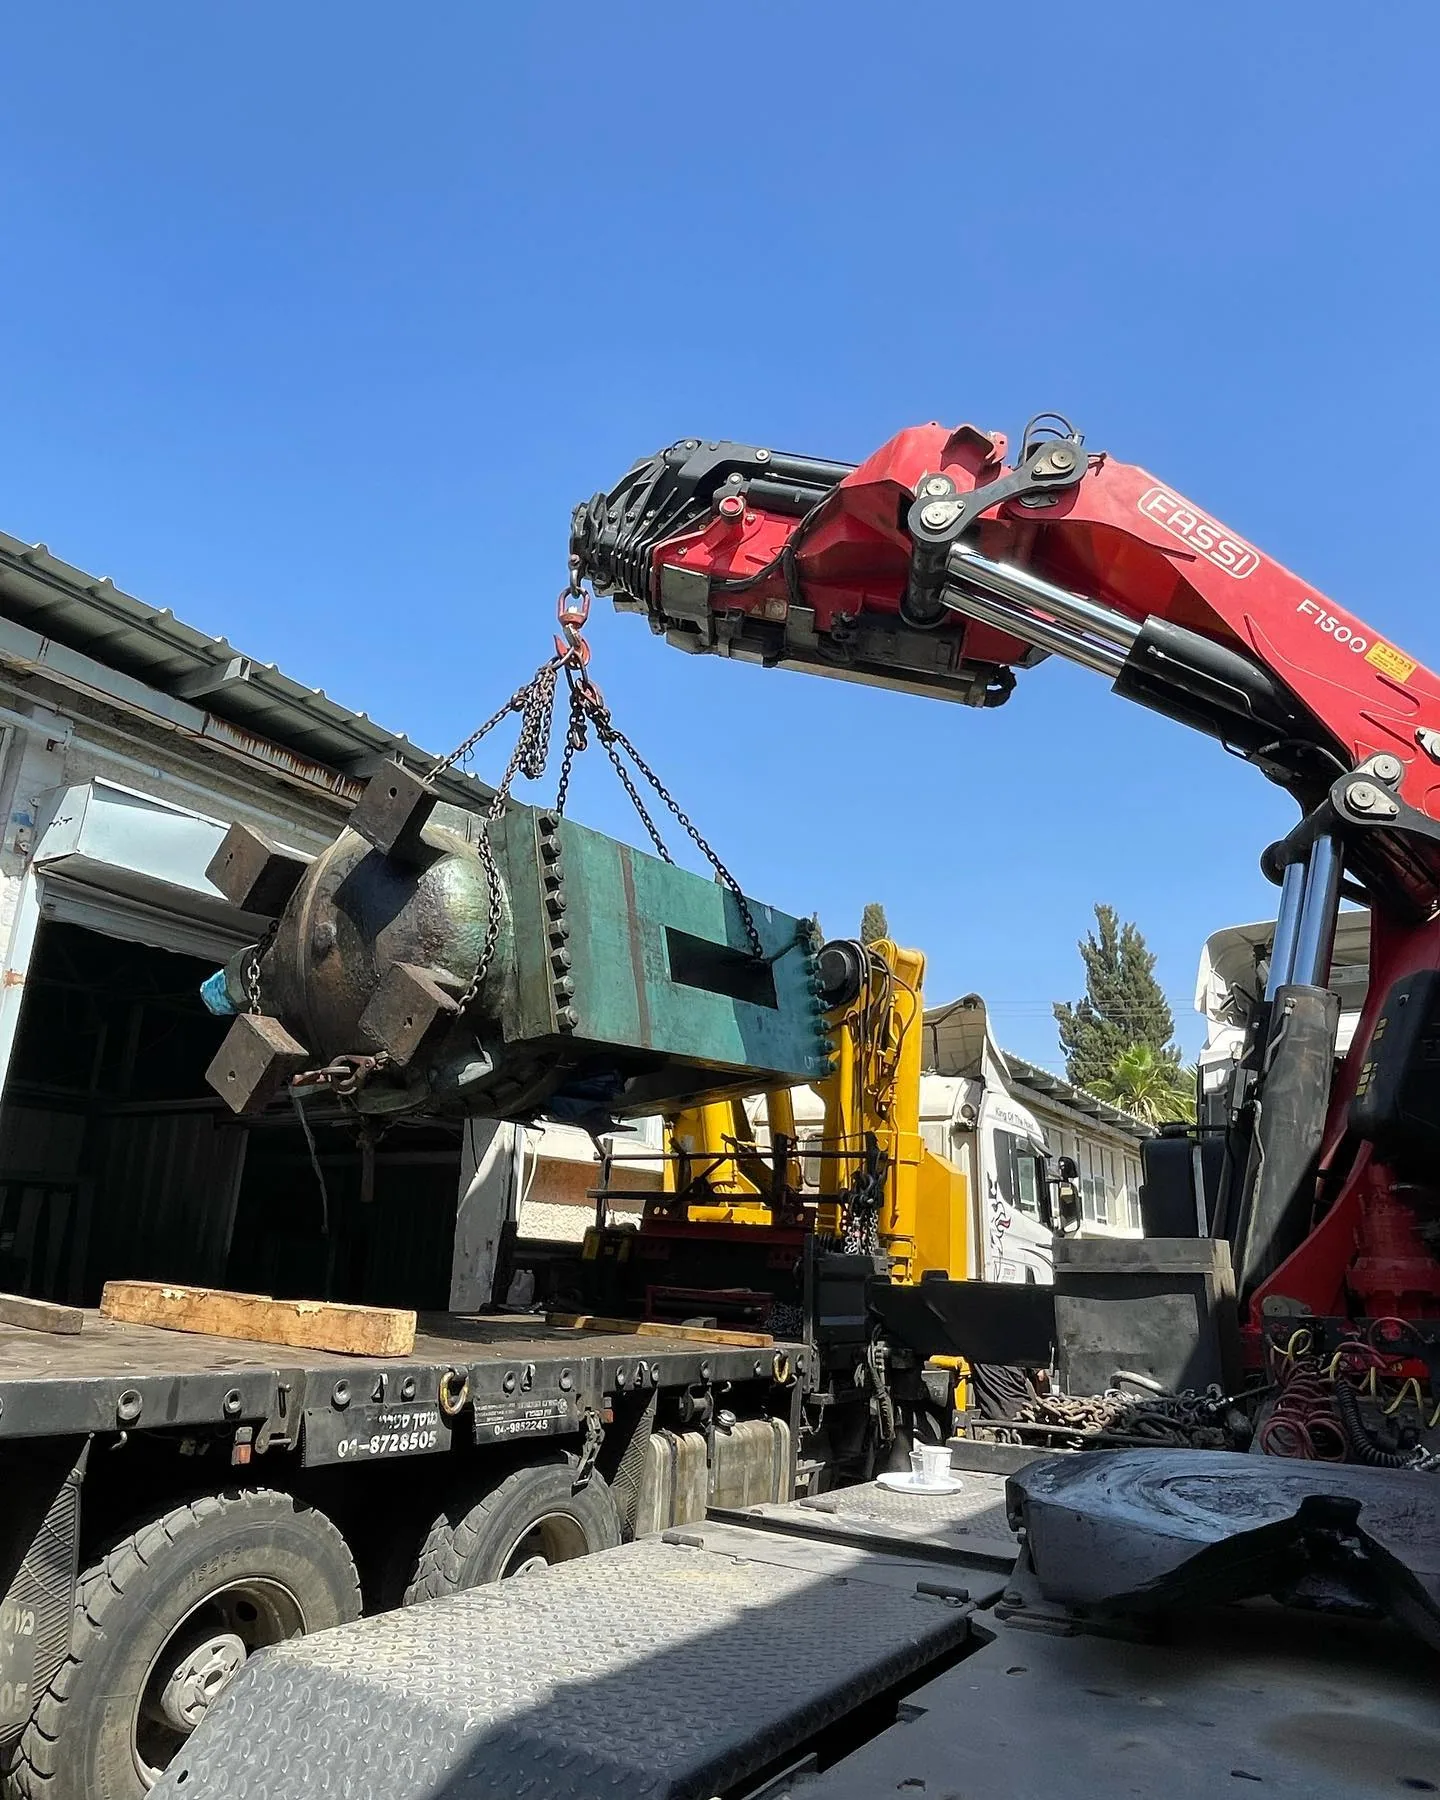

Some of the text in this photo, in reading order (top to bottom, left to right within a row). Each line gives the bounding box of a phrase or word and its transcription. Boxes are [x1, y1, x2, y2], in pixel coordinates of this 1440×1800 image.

[1146, 494, 1250, 572] FASSI
[1296, 598, 1367, 653] F1500
[412, 1411, 437, 1431] מוסך
[338, 1431, 437, 1457] 04-8728505
